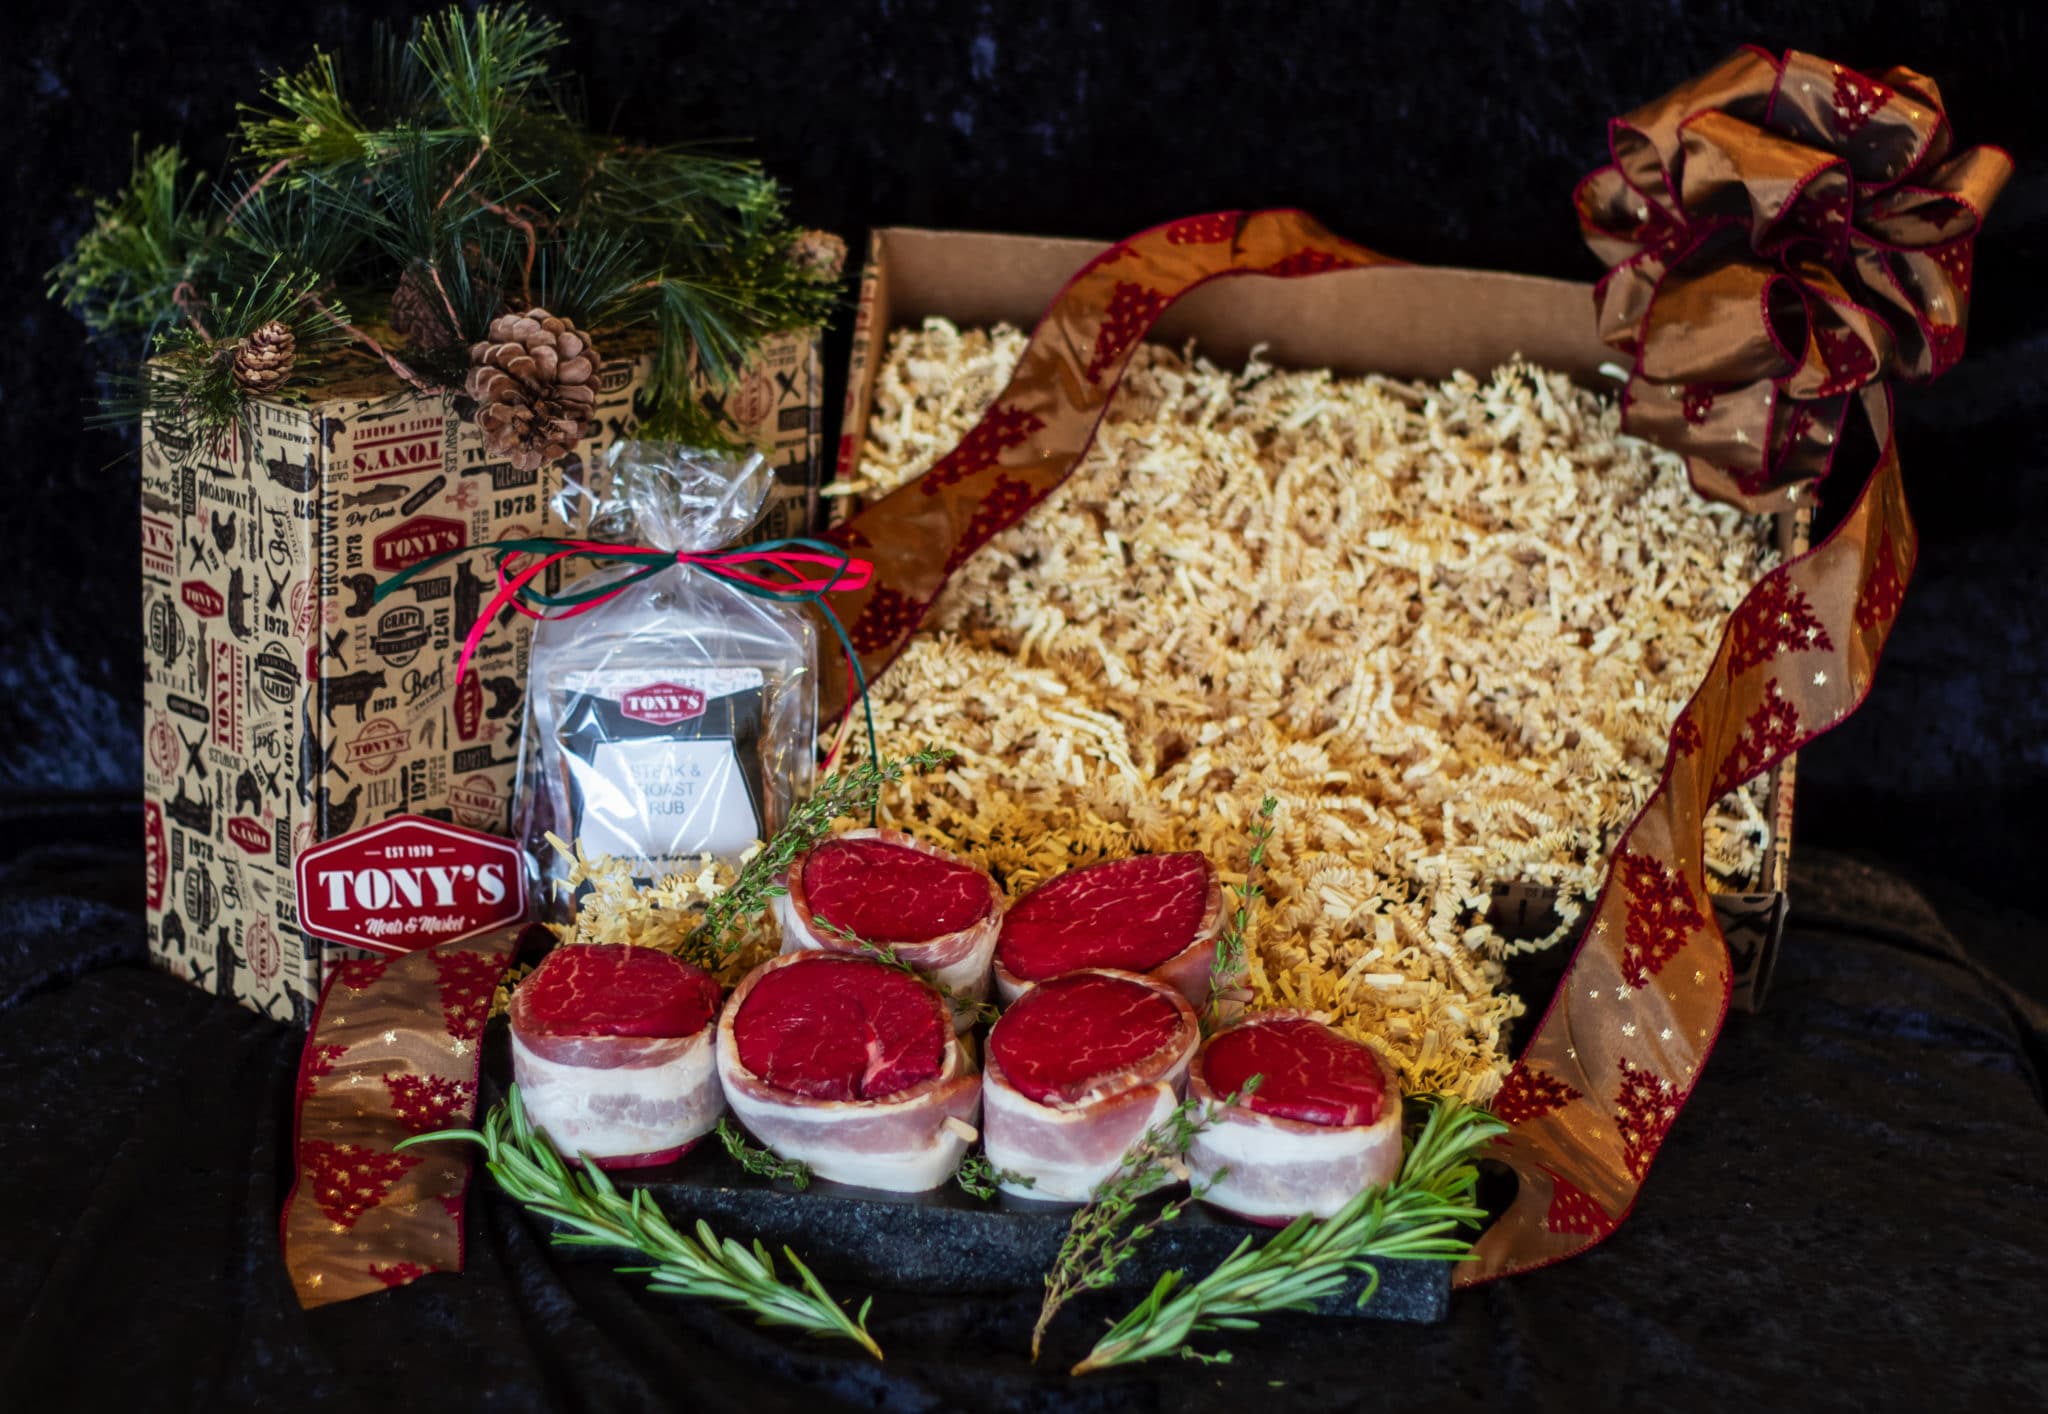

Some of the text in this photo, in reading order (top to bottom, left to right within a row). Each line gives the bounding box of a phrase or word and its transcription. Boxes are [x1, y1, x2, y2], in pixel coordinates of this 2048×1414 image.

[353, 424, 397, 441] MARKET
[353, 440, 442, 475] TONY'S
[494, 494, 536, 520] 1978
[264, 506, 294, 566] Beef
[320, 489, 339, 597] BROADWAY
[381, 529, 460, 562] TONY'S
[346, 533, 363, 570] 1978
[184, 588, 222, 611] TONY'S
[264, 614, 289, 638] 1978
[384, 611, 418, 629] CRAFT
[434, 607, 449, 650] 1978
[216, 641, 231, 748] TONY'S
[402, 656, 446, 707] Beef
[373, 697, 397, 713] 1978
[628, 695, 700, 711] TONY'S
[284, 705, 294, 782] LOCAL
[354, 736, 405, 758] TONY'S
[411, 758, 426, 803] 1978
[649, 799, 685, 816] RUB
[189, 836, 214, 862] 1978
[385, 846, 404, 859] EST
[217, 853, 243, 910] Beef
[318, 863, 506, 912] TONY'S
[276, 900, 298, 924] 978
[365, 914, 466, 937] Meats & Market
